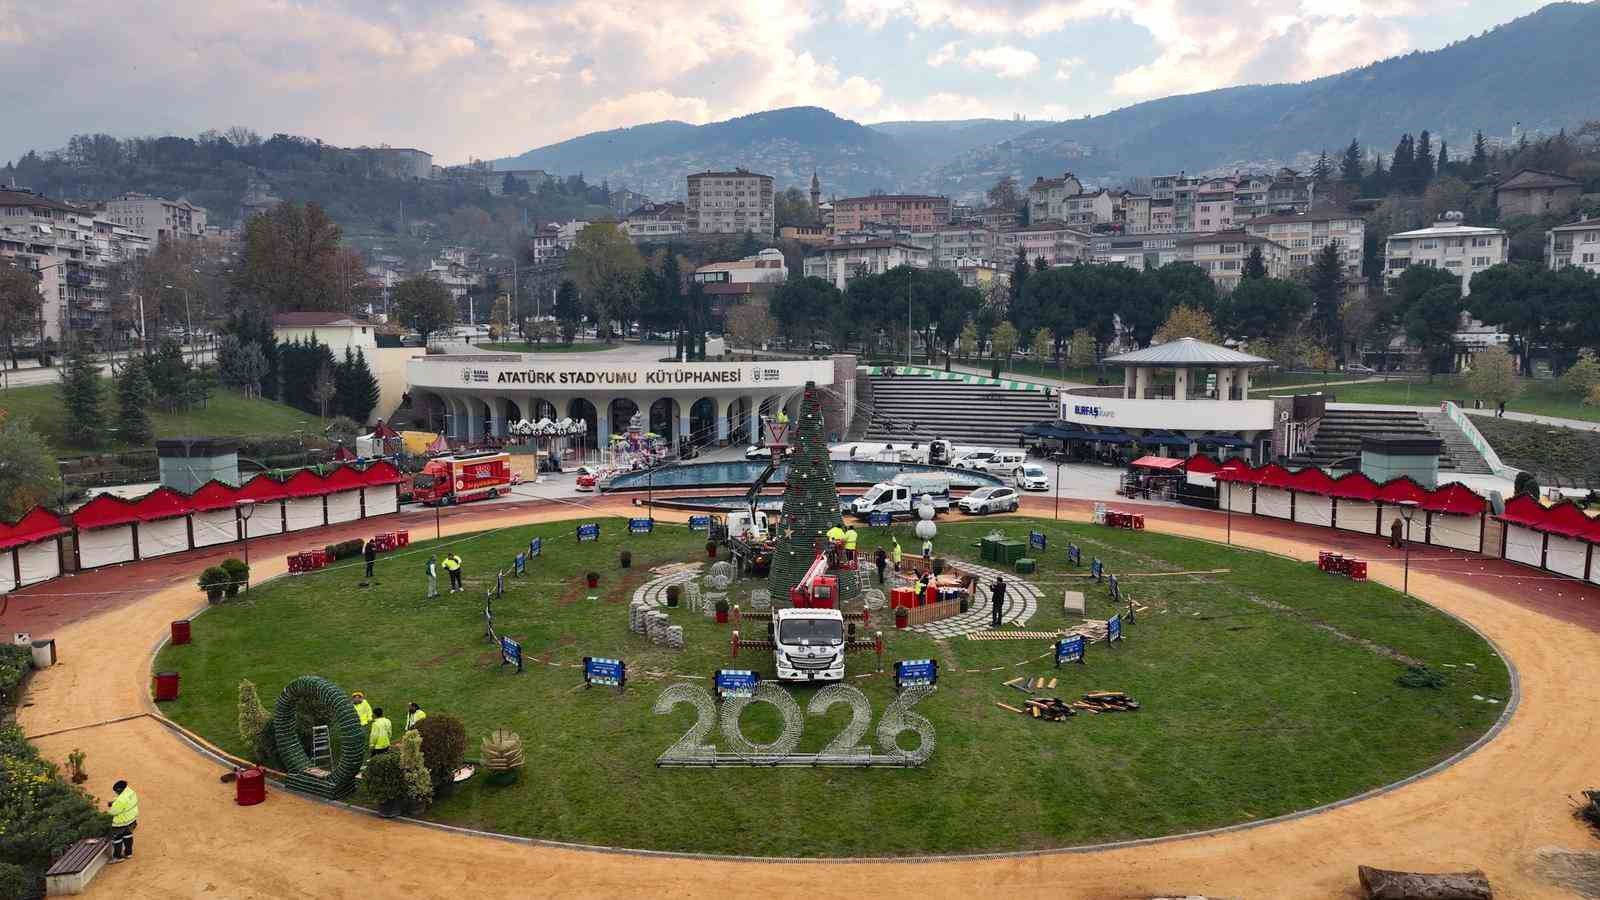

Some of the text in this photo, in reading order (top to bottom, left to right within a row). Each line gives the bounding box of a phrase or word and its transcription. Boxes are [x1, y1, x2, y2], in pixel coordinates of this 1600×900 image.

[497, 369, 556, 384] ATATÜRK
[559, 371, 637, 384] STADYUMU
[646, 368, 742, 384] KÜTÜPHANESİ
[652, 681, 937, 768] 2026
